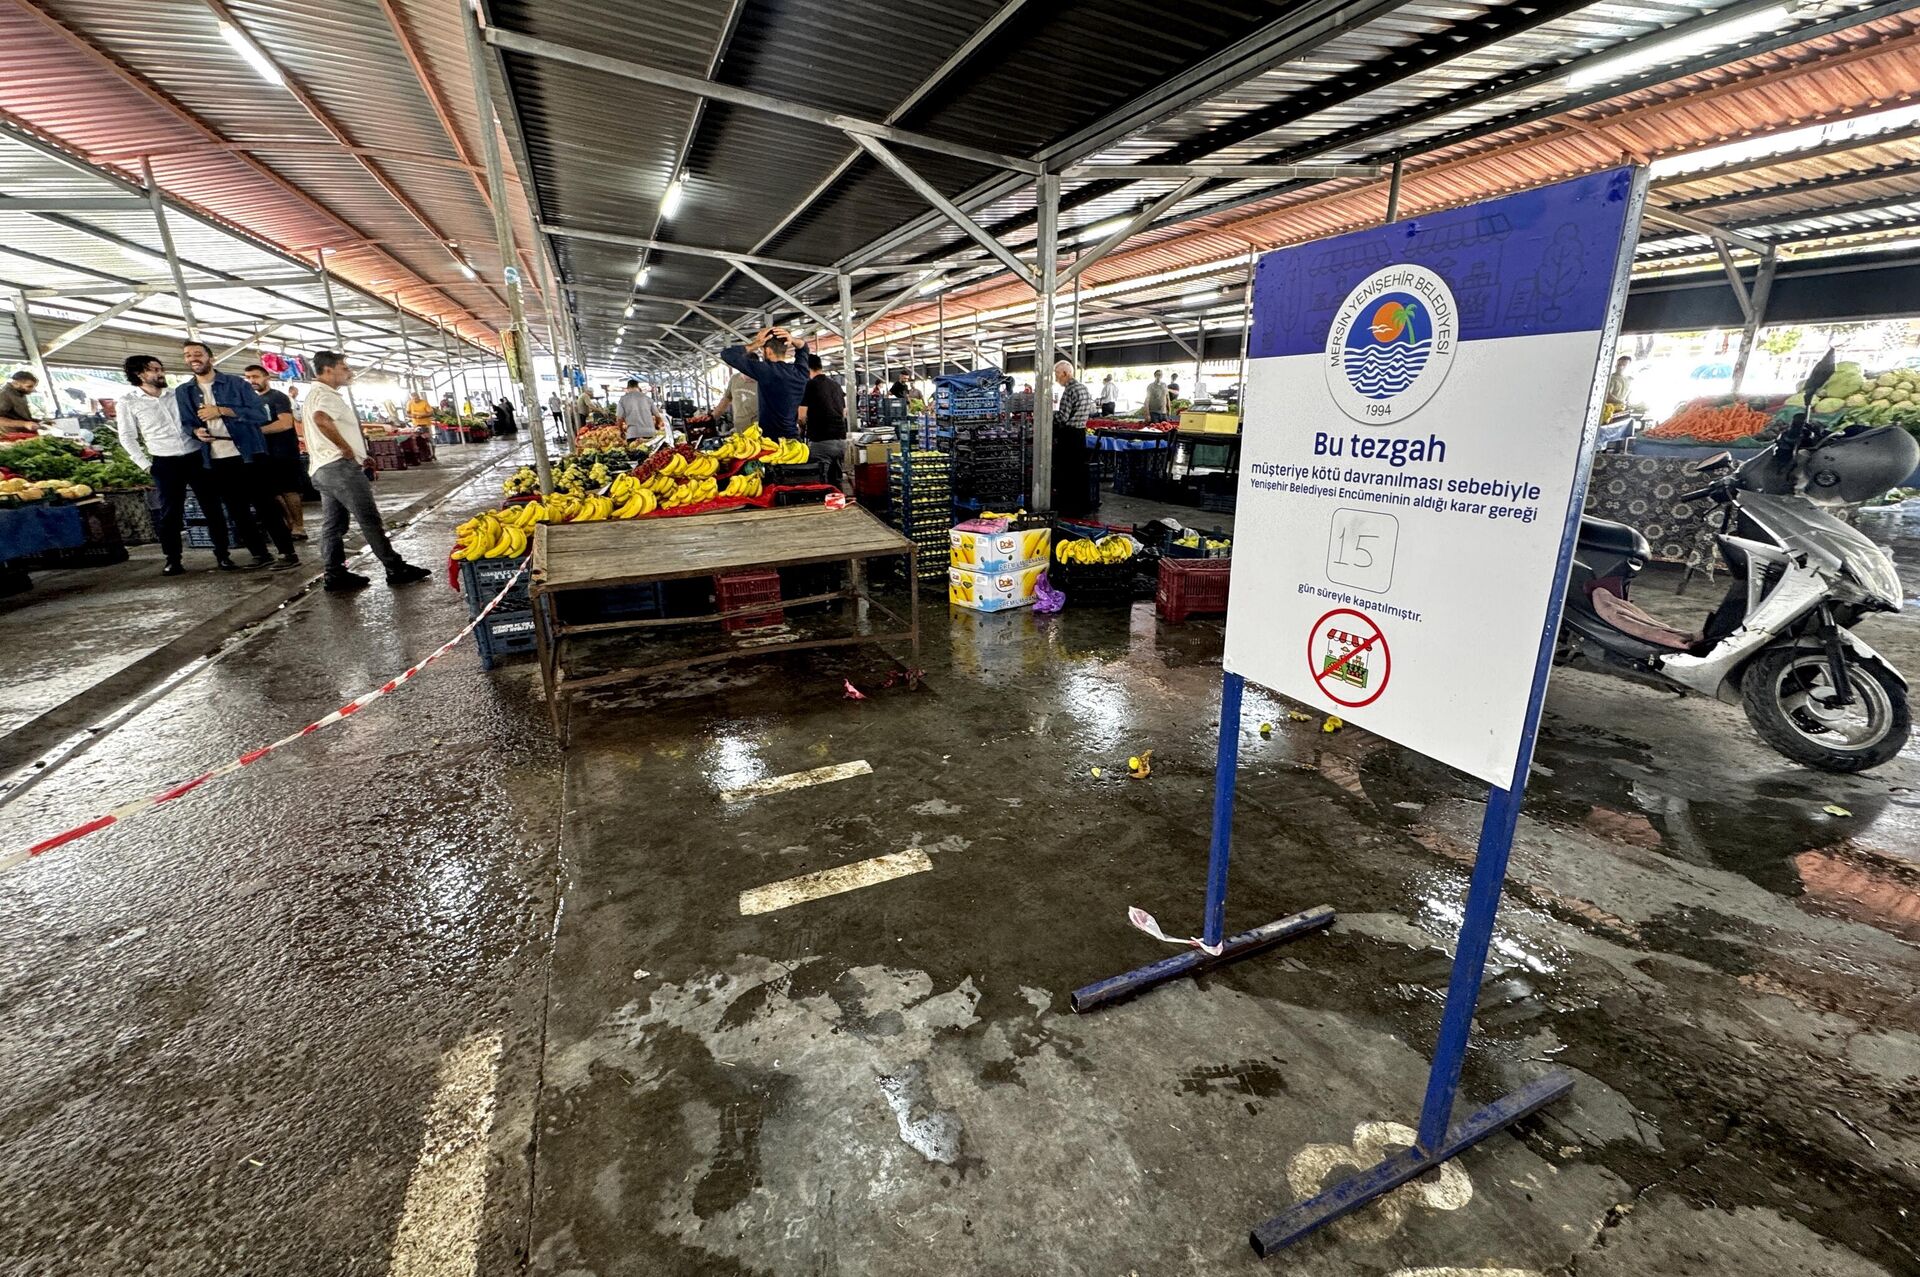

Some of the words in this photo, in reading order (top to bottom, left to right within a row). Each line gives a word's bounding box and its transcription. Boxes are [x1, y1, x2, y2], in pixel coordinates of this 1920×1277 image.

[1348, 270, 1415, 311] YENİŞEHİR
[1365, 404, 1392, 417] 1994
[1314, 432, 1344, 457] Bu
[1350, 434, 1446, 468] tezgah
[1250, 478, 1289, 491] Yenişehir
[1290, 482, 1337, 498] Belediyesi
[1339, 488, 1411, 506] Encümeninin
[1413, 495, 1448, 513] aldığı
[1450, 498, 1487, 514] karar
[1488, 505, 1538, 523] gereği
[1251, 461, 1309, 480] müşteriye
[1311, 465, 1341, 481] kötü
[1344, 468, 1443, 491] davranılması
[1447, 477, 1541, 502] sebebiyle
[999, 539, 1014, 549] Dole
[1333, 527, 1380, 568] 15
[998, 578, 1013, 588] Dole
[1297, 583, 1315, 594] gün
[1317, 588, 1351, 604] süreyle
[1353, 595, 1422, 622] kapatılmıştır.
